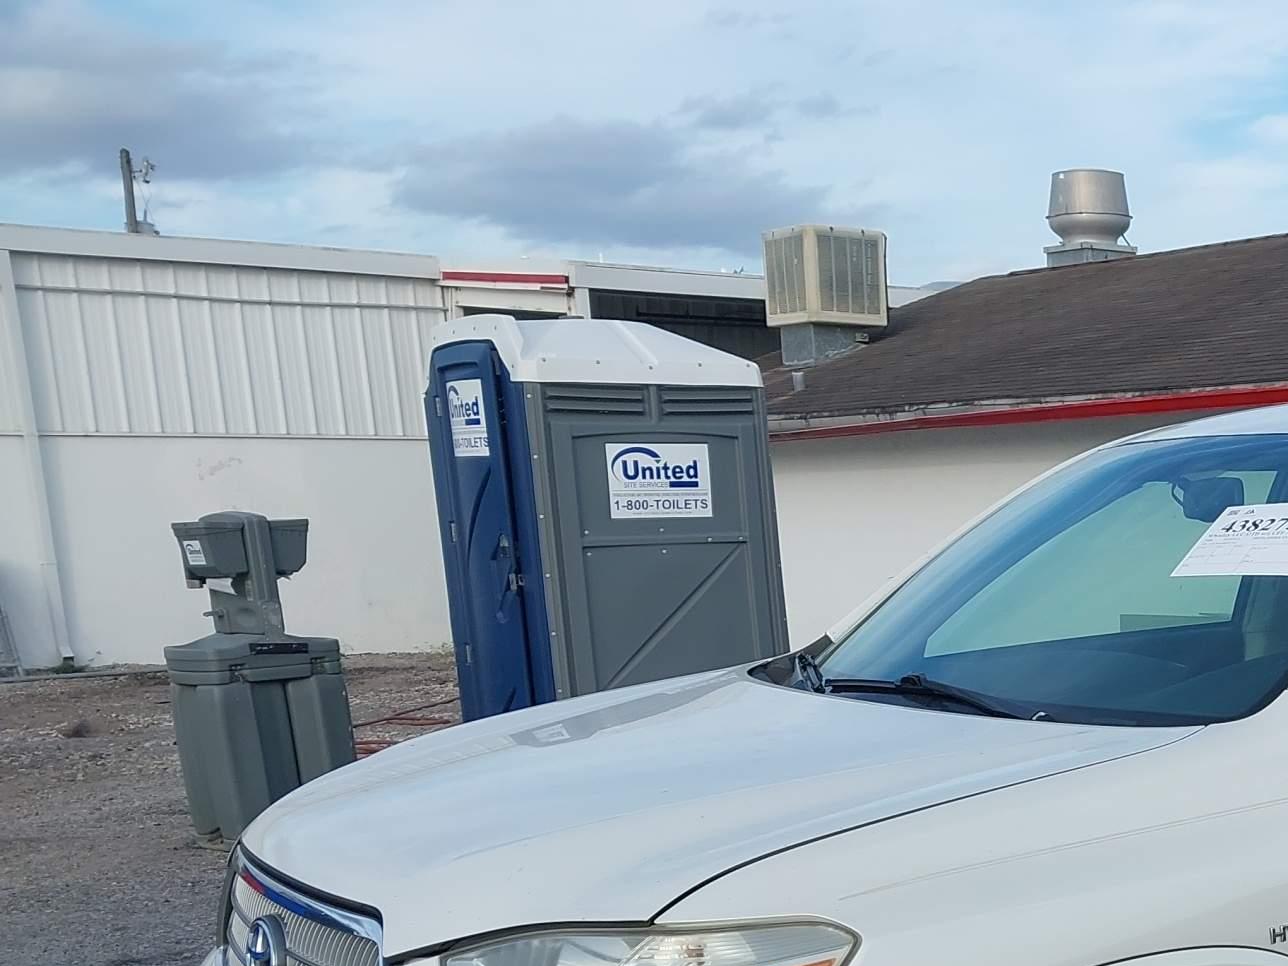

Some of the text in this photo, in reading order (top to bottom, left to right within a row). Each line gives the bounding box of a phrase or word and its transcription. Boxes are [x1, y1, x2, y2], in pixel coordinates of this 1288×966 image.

[449, 395, 480, 419] United
[622, 459, 698, 480] United
[614, 499, 708, 511] 1-800-TOILETS
